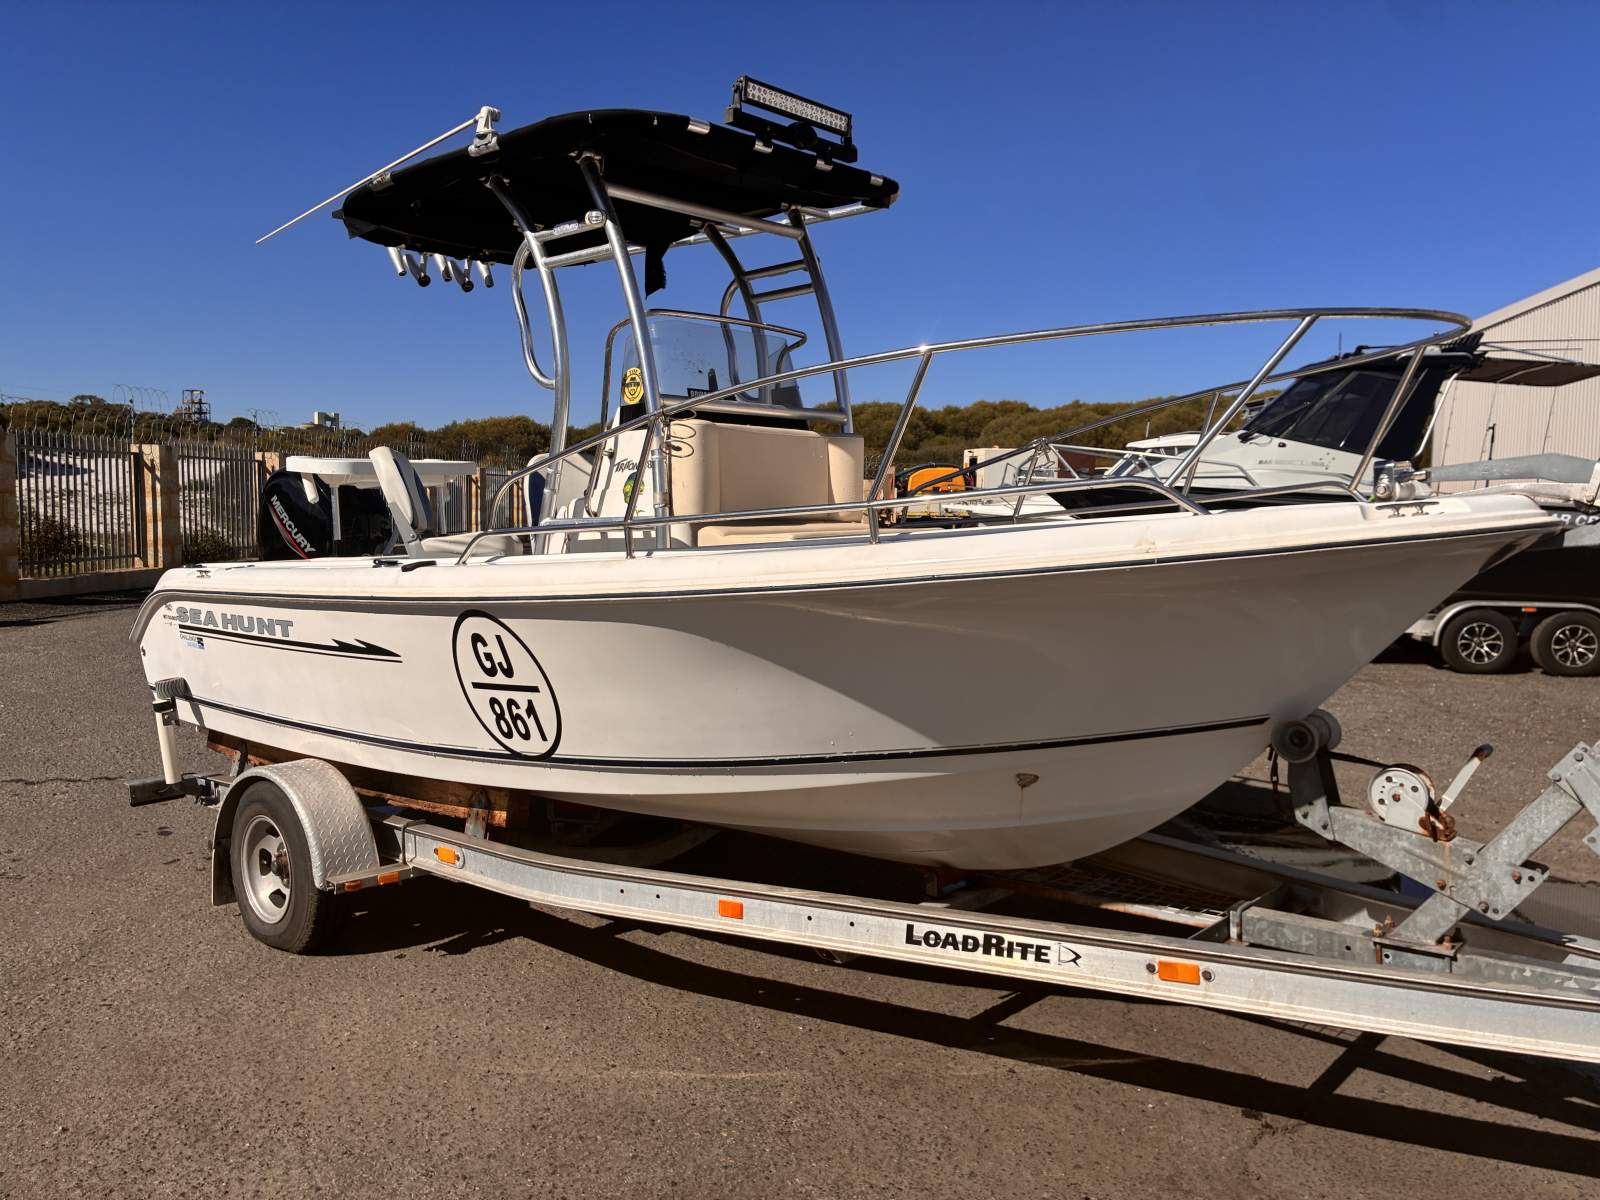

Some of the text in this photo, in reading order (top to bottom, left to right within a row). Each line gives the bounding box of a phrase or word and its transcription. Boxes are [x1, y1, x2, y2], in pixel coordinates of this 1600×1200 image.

[271, 494, 317, 553] MERCURY
[176, 606, 294, 638] SEA HUNT
[471, 632, 515, 679] GJ
[489, 696, 549, 742] 861
